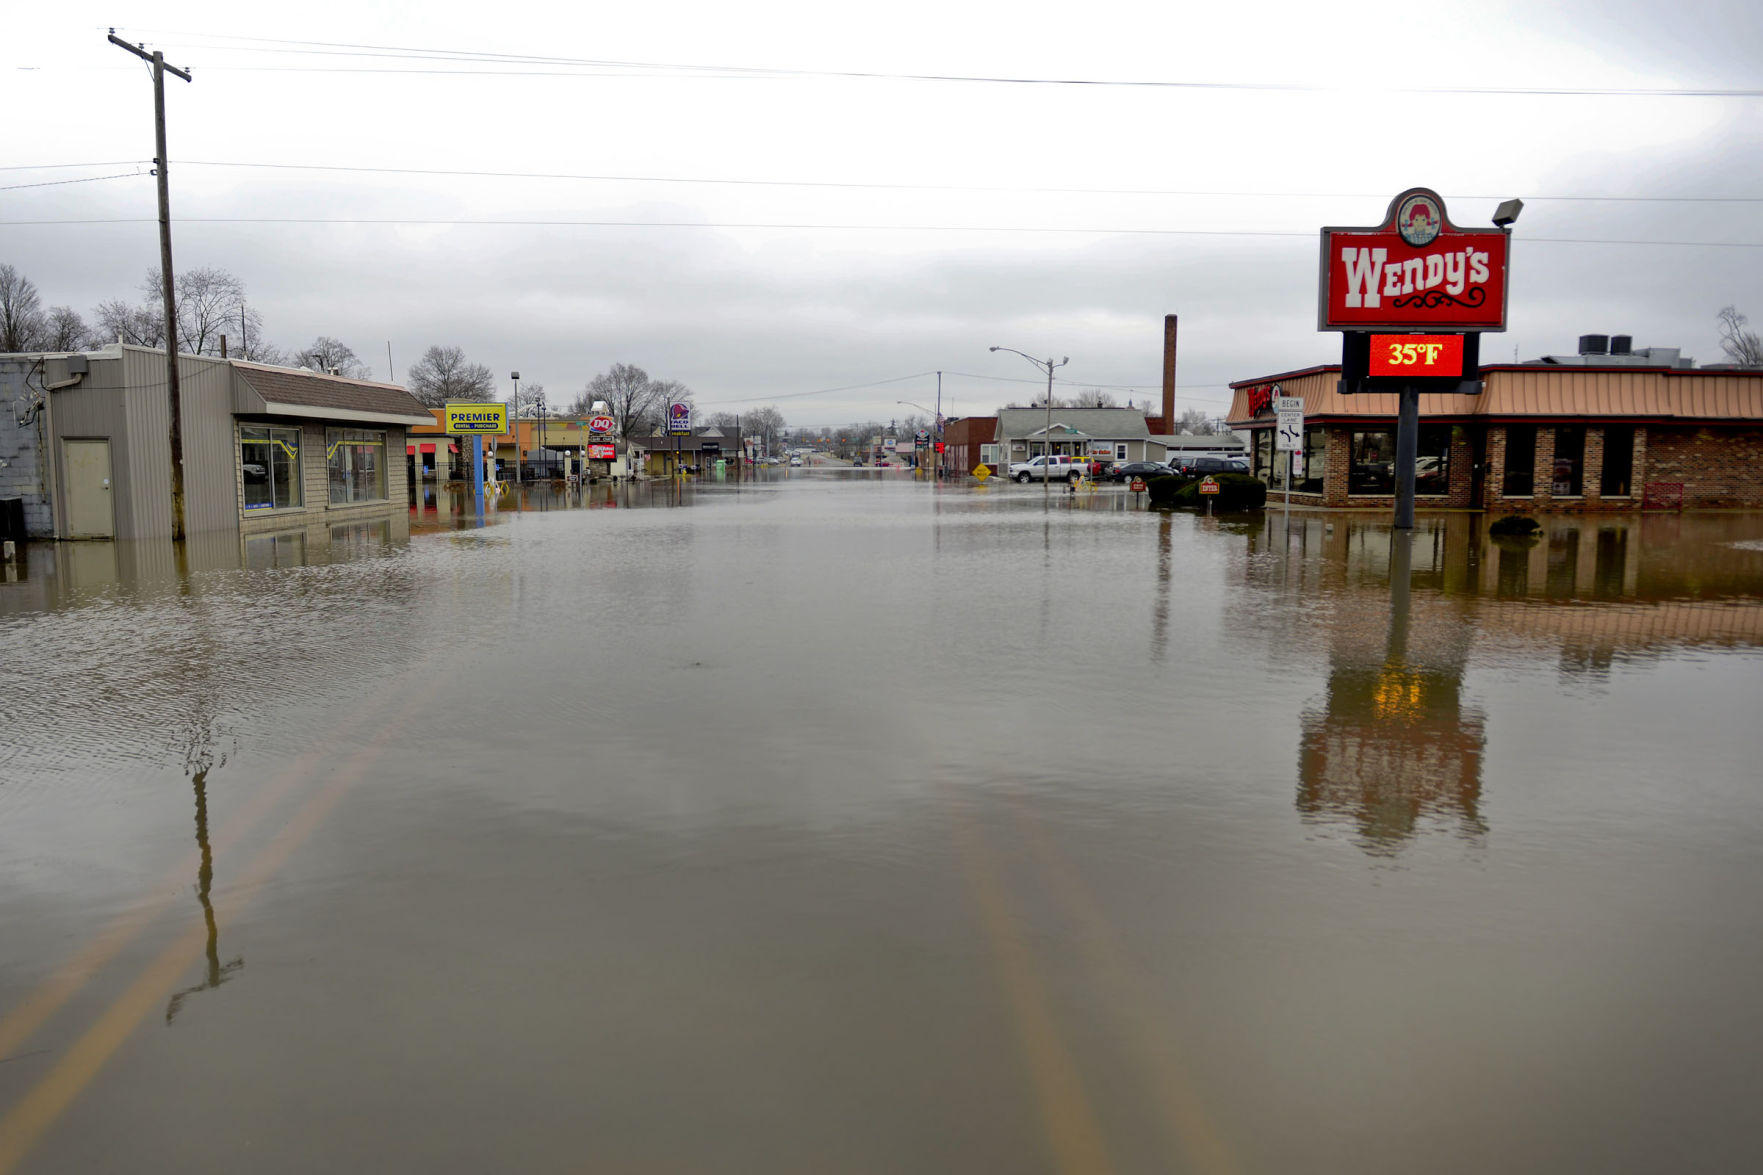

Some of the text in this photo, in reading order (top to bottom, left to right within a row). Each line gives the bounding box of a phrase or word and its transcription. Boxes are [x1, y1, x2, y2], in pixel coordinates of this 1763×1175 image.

[1388, 343, 1443, 365] 35°F
[1282, 399, 1300, 408] BEGIN
[451, 413, 501, 421] PREMIER
[593, 419, 610, 429] DQ
